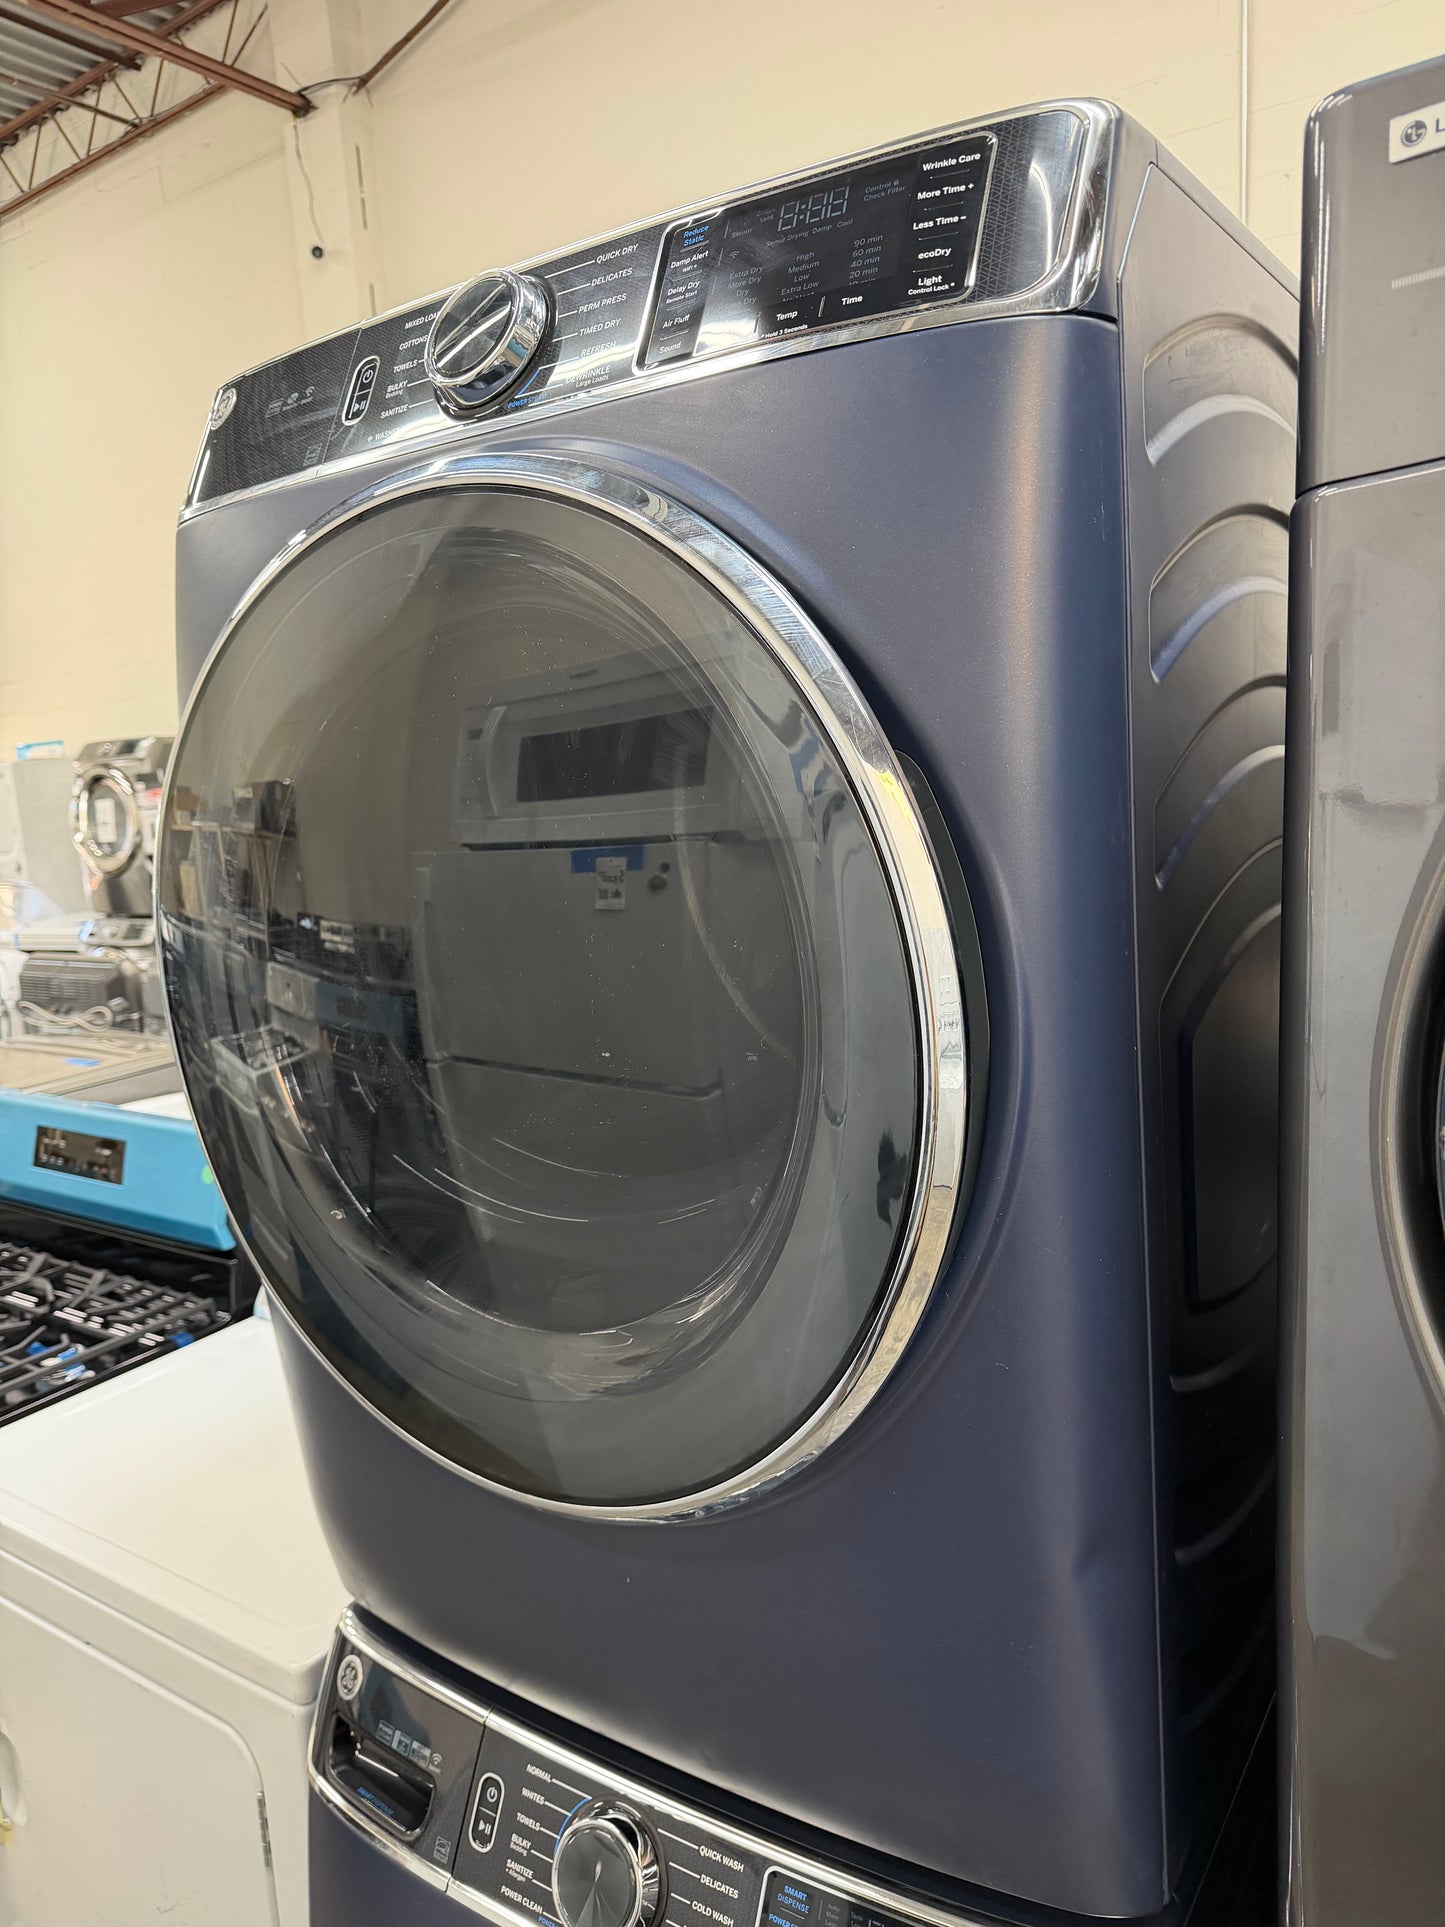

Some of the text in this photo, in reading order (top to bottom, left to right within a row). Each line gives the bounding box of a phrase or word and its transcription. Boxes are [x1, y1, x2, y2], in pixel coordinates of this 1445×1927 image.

[923, 152, 981, 172] Wrinkle Care
[864, 185, 906, 201] Check Filter
[865, 181, 892, 194] Control
[918, 189, 940, 200] More
[943, 184, 966, 194] Time
[788, 230, 809, 240] Drying
[812, 224, 832, 234] Damp
[837, 219, 853, 228] Cool
[913, 220, 933, 230] Less
[936, 215, 959, 226] Time
[683, 225, 709, 238] Reduce
[731, 228, 752, 238] Steam
[684, 235, 705, 246] Static
[867, 235, 883, 244] min
[596, 244, 639, 264] QUICK DRY
[796, 252, 815, 261] High
[866, 245, 881, 254] min
[918, 248, 951, 259] ecoDry
[670, 250, 709, 269] Damp Alert
[851, 256, 880, 268] 40 min
[729, 266, 764, 280] Extra Dry
[788, 261, 820, 274] Medium
[862, 267, 878, 276] min
[591, 268, 633, 286] DELICATES
[748, 276, 762, 285] Dry
[794, 273, 810, 282] Low
[918, 275, 942, 286] Light
[667, 280, 700, 296] Delay Dry
[736, 288, 750, 297] Dry
[781, 280, 820, 296] Extra Low
[908, 284, 949, 296] Control Lock
[578, 293, 627, 314] PERM PRESS
[666, 290, 698, 304] Remote Start
[842, 295, 863, 306] Time
[404, 311, 438, 330] MIXED LOA
[663, 314, 690, 329] Air Fluff
[776, 310, 798, 322] Temp
[580, 318, 621, 336] TIMED DRY
[784, 324, 808, 334] Seconds
[399, 334, 429, 350] COTTONS
[581, 341, 617, 357] REFRESH
[659, 341, 681, 354] Sound
[393, 359, 418, 373] TOWELS
[566, 365, 611, 384] DEWRINKLE
[576, 374, 609, 388] Large Loads
[387, 380, 408, 393] BULKY
[380, 404, 409, 419] SANITIZE
[526, 1763, 551, 1783] NORMAL
[522, 1787, 545, 1805] WHITES
[516, 1812, 541, 1832] TOWELS
[511, 1833, 532, 1848] BULKY
[699, 1845, 744, 1873] QUICK WASH
[506, 1859, 534, 1879] SANITIZE
[509, 1870, 526, 1883] Allergen
[700, 1874, 739, 1899] DELICATES
[784, 1885, 807, 1901] SMART
[501, 1885, 544, 1915] POWER CLEAN
[777, 1893, 810, 1914] DISPENSE
[691, 1900, 734, 1927] COLD WASH
